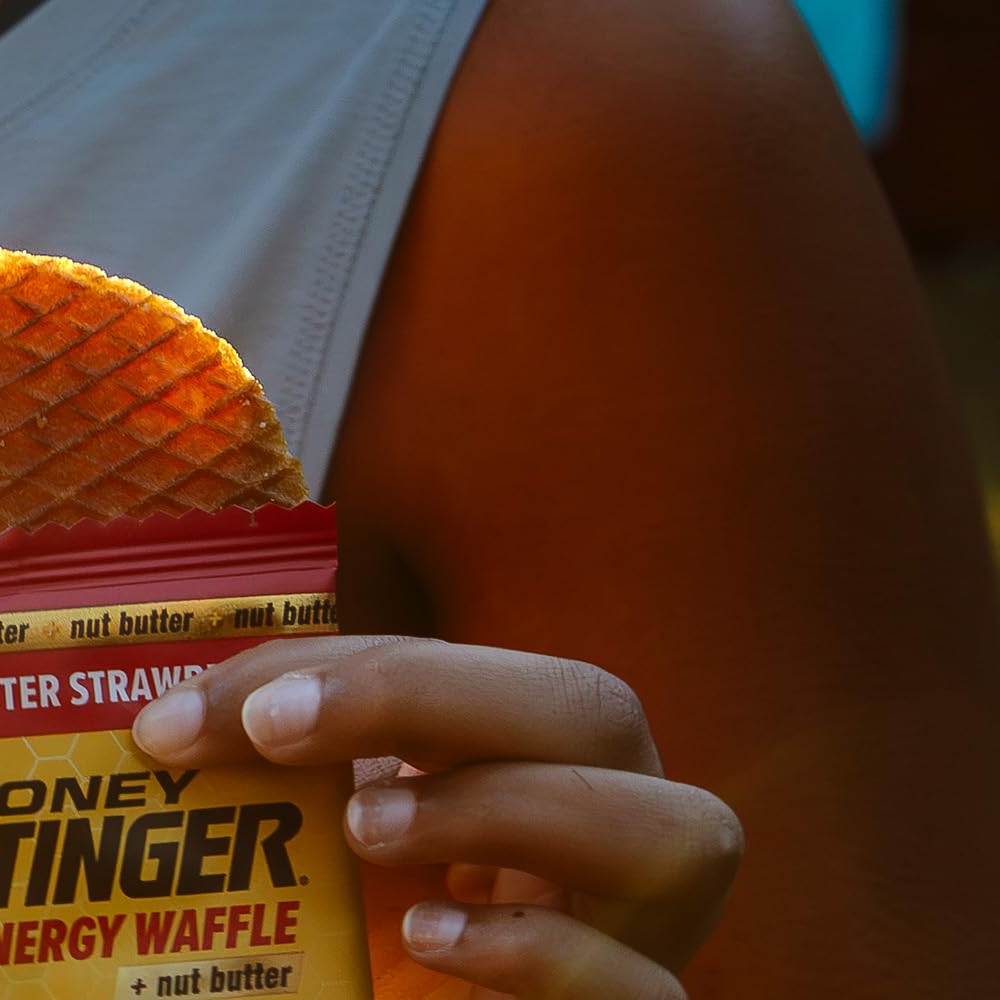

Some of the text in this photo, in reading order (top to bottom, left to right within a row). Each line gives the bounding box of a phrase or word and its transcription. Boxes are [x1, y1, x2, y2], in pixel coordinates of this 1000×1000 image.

[70, 611, 111, 639] nut
[119, 608, 194, 635] butter
[234, 602, 274, 628] nut
[69, 663, 217, 706] STRAW
[130, 901, 301, 956] WAFFLE
[157, 968, 201, 997] nut
[210, 963, 294, 993] butter
